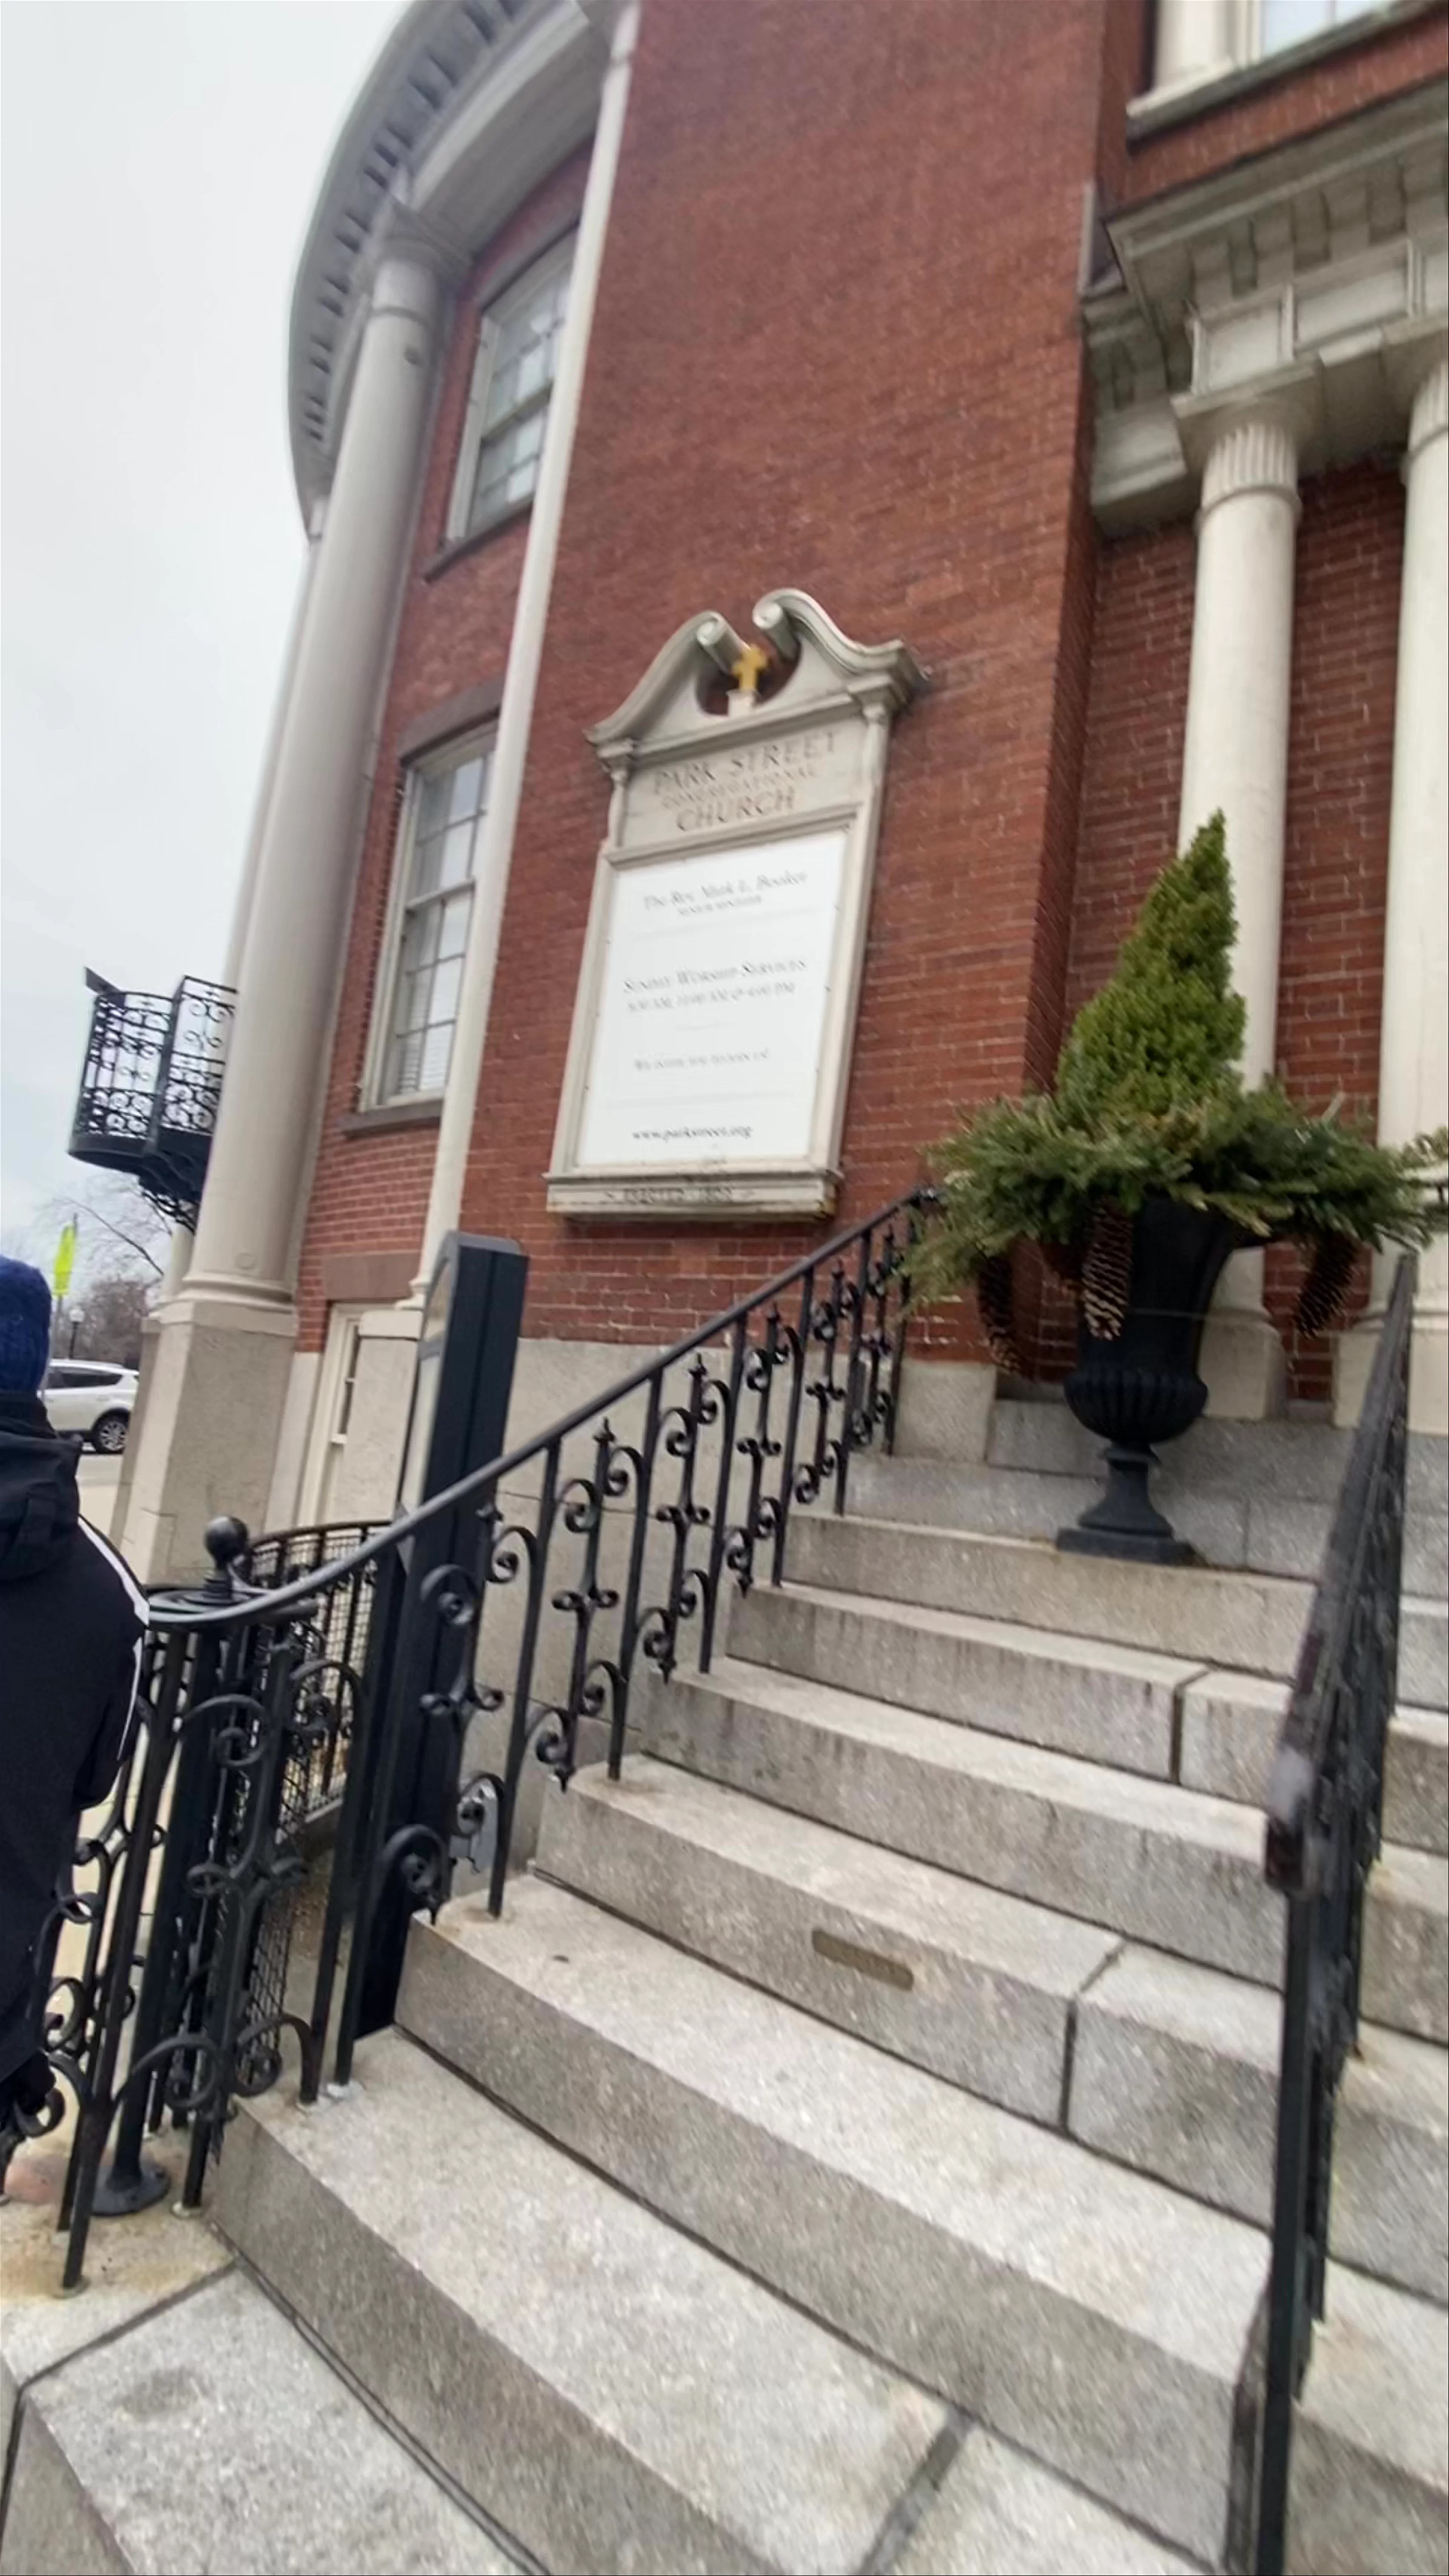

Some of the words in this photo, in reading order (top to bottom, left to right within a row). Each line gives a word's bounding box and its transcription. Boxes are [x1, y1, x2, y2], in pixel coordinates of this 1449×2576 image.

[654, 761, 715, 795] PARK
[729, 729, 838, 777] STREET
[677, 786, 795, 831] CHURCH
